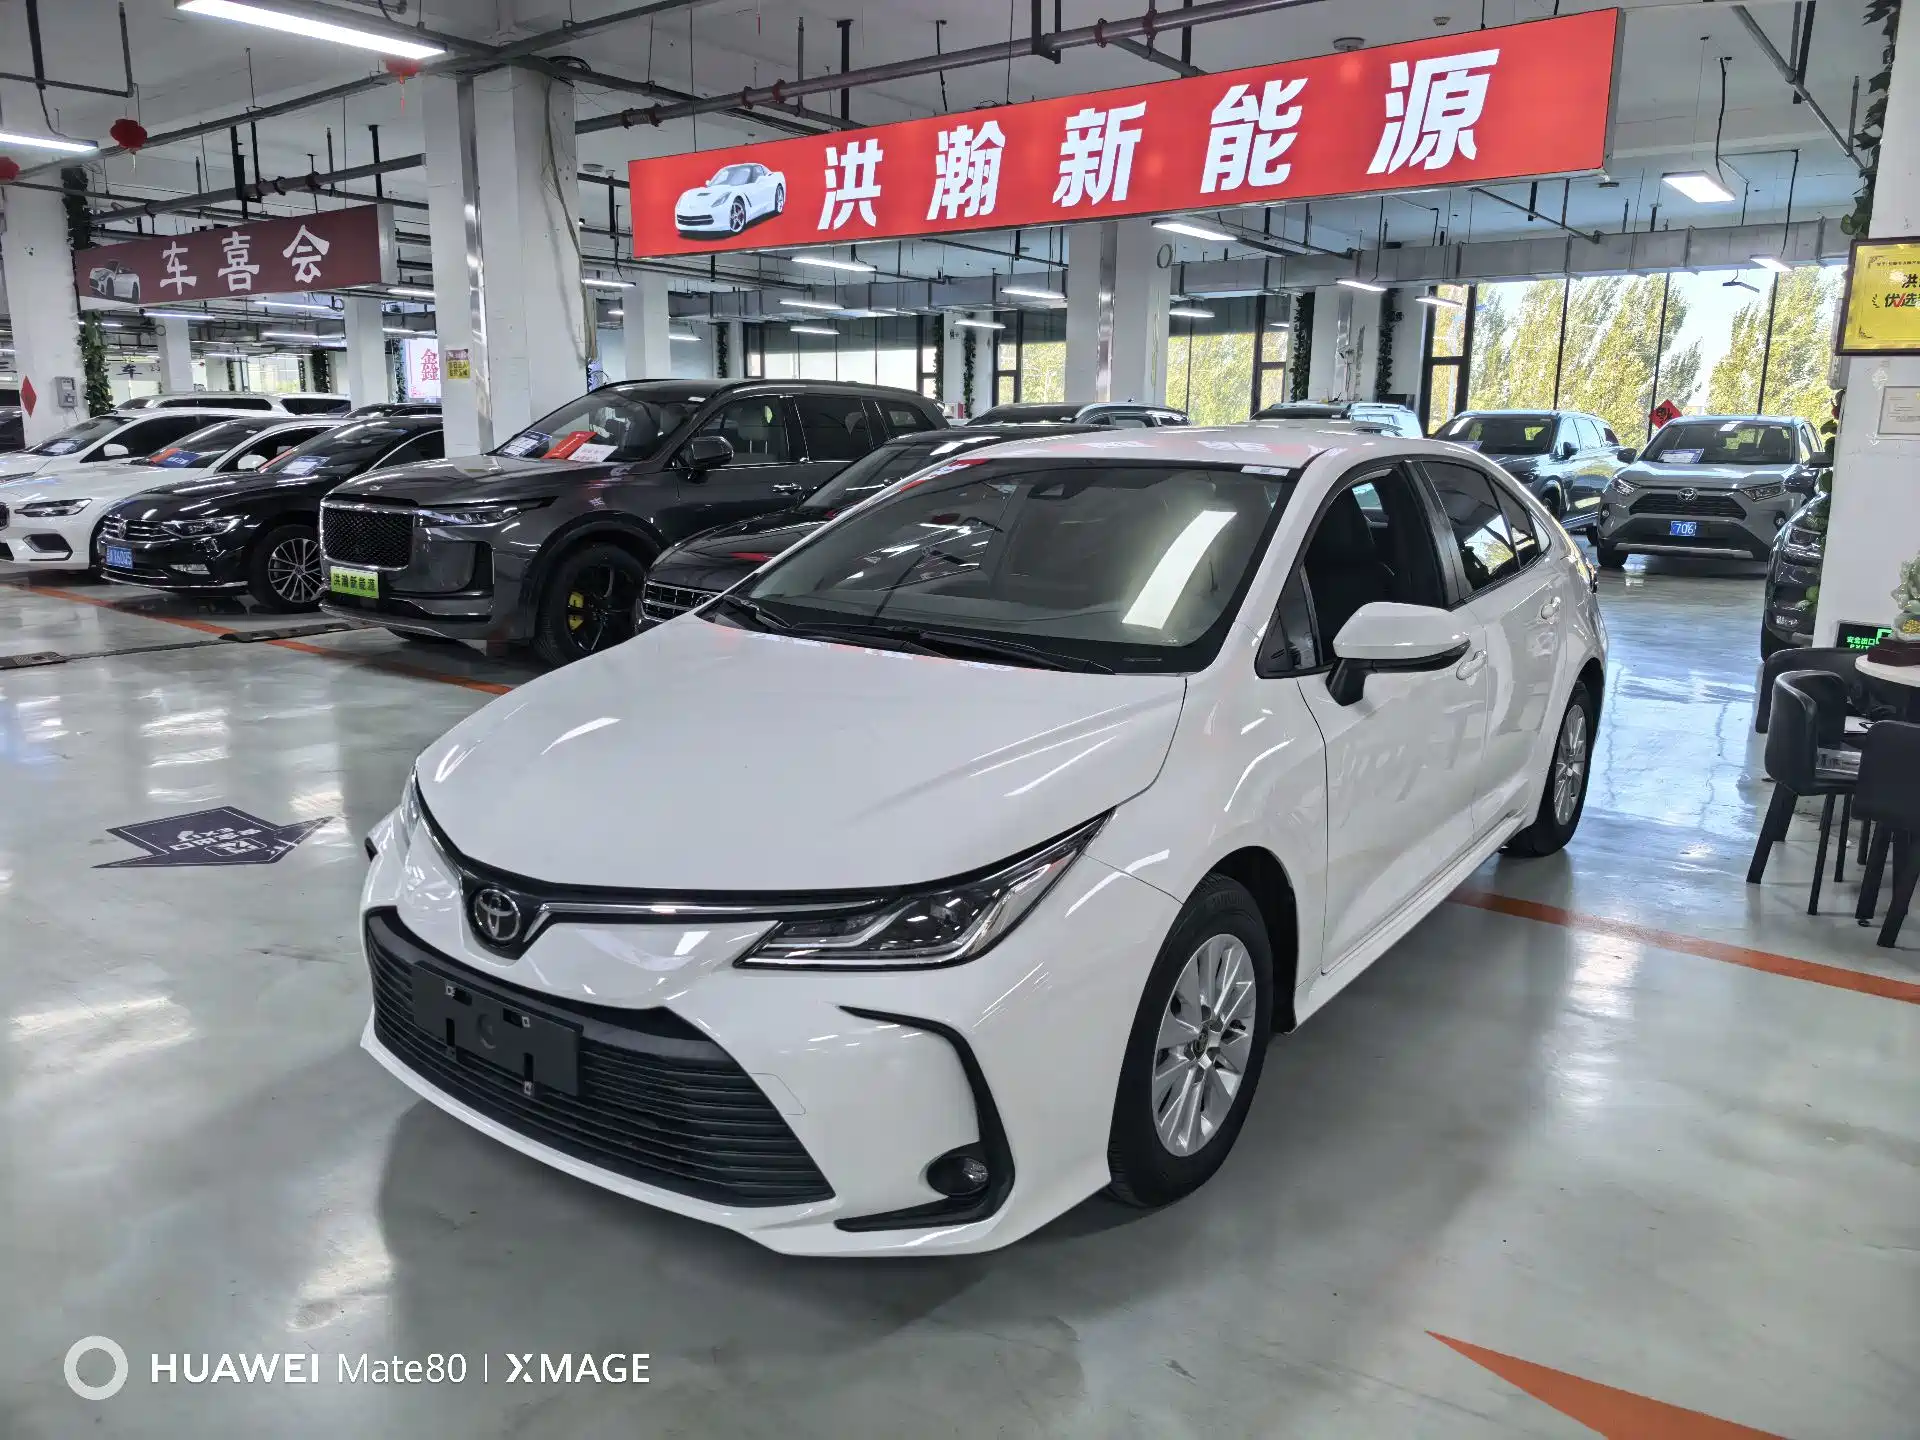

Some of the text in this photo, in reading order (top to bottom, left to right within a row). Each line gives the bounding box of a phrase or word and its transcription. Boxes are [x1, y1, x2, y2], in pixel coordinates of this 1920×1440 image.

[817, 48, 1500, 230] 洪瀚新能源
[160, 225, 330, 295] 车喜会
[1902, 273, 1920, 288] 洪
[1885, 292, 1920, 308] 优选
[1675, 524, 1694, 534] 706
[333, 573, 376, 592] 洪瀚新能源
[1847, 636, 1875, 645] 安全出口
